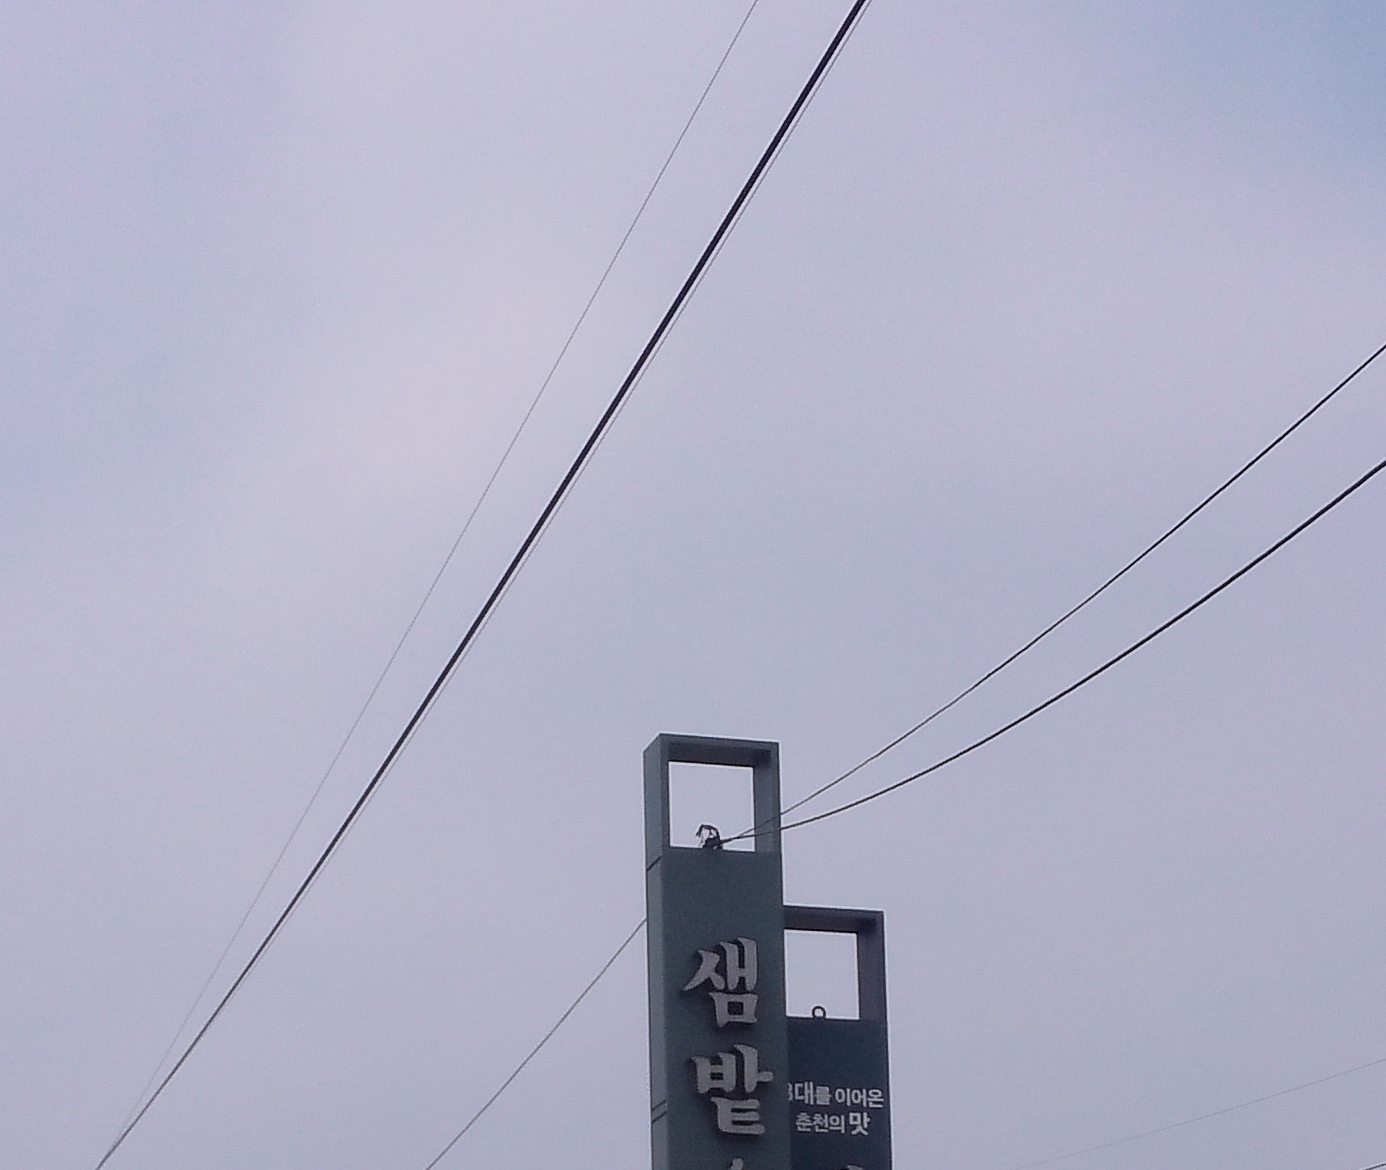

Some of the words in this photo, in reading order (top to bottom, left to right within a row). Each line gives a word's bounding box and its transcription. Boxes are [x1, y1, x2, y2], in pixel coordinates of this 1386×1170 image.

[834, 1087, 885, 1108] 이어온
[795, 1112, 846, 1134] 춘천의
[849, 1111, 871, 1136] 맛
